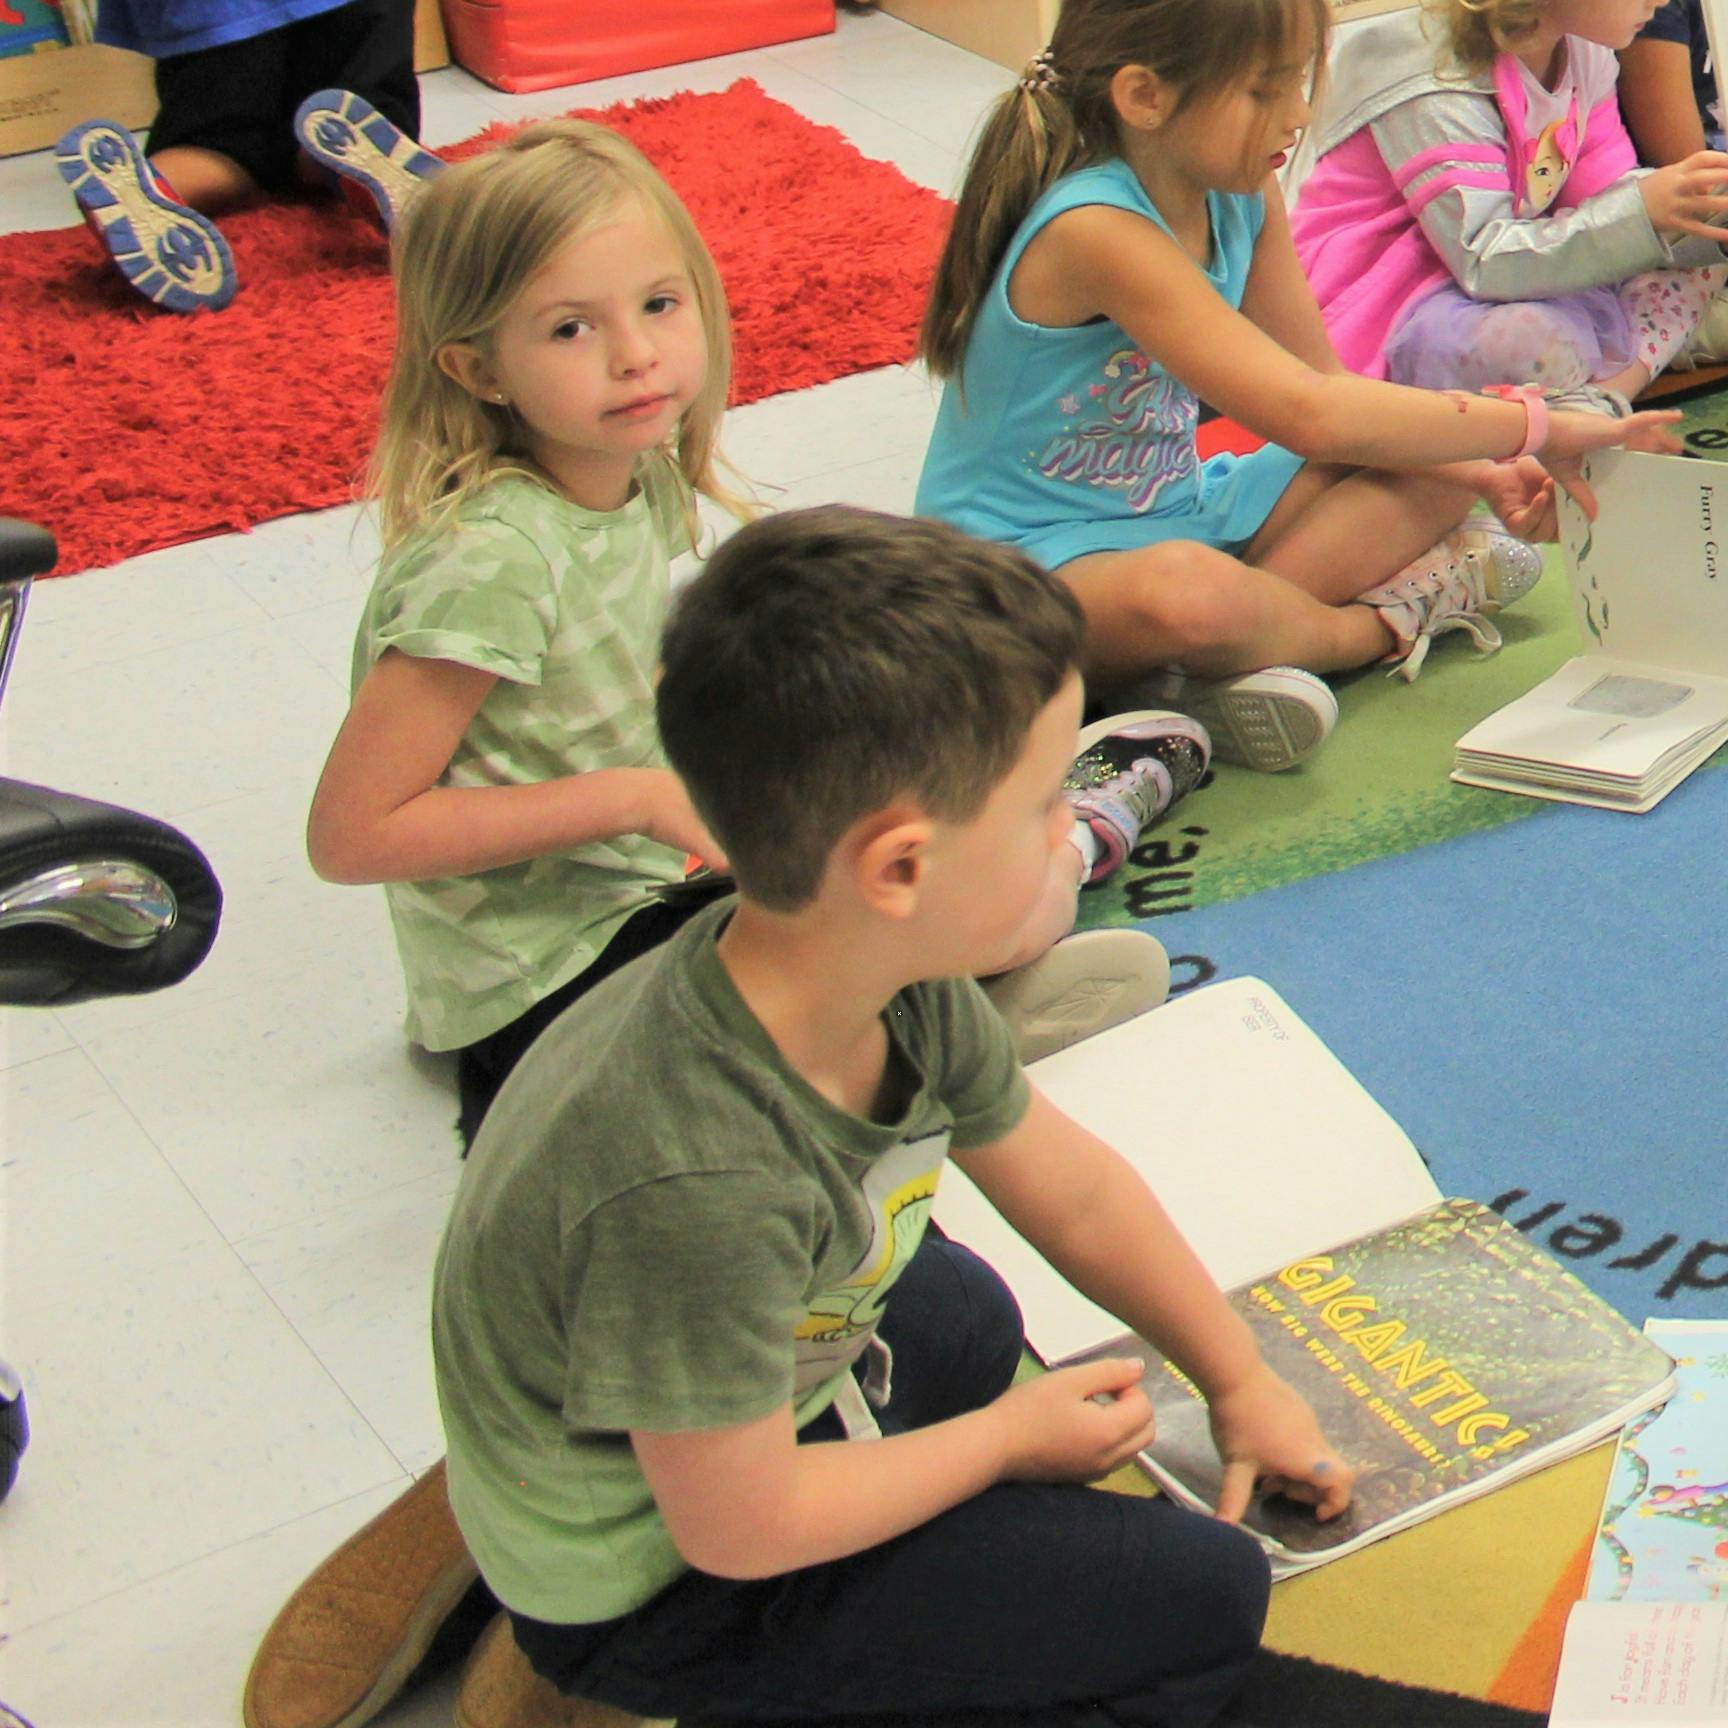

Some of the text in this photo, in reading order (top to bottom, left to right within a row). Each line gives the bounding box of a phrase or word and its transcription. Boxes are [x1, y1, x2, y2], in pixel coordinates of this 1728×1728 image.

[1699, 484, 1714, 533] Furry
[1703, 540, 1719, 580] Gray
[1124, 825, 1210, 919] me,
[1249, 1285, 1286, 1315] HOW
[1280, 1314, 1309, 1338] BIG
[1305, 1337, 1345, 1374] WERE
[1341, 1372, 1371, 1398] THE
[1277, 1256, 1531, 1462] GIGANTIC!
